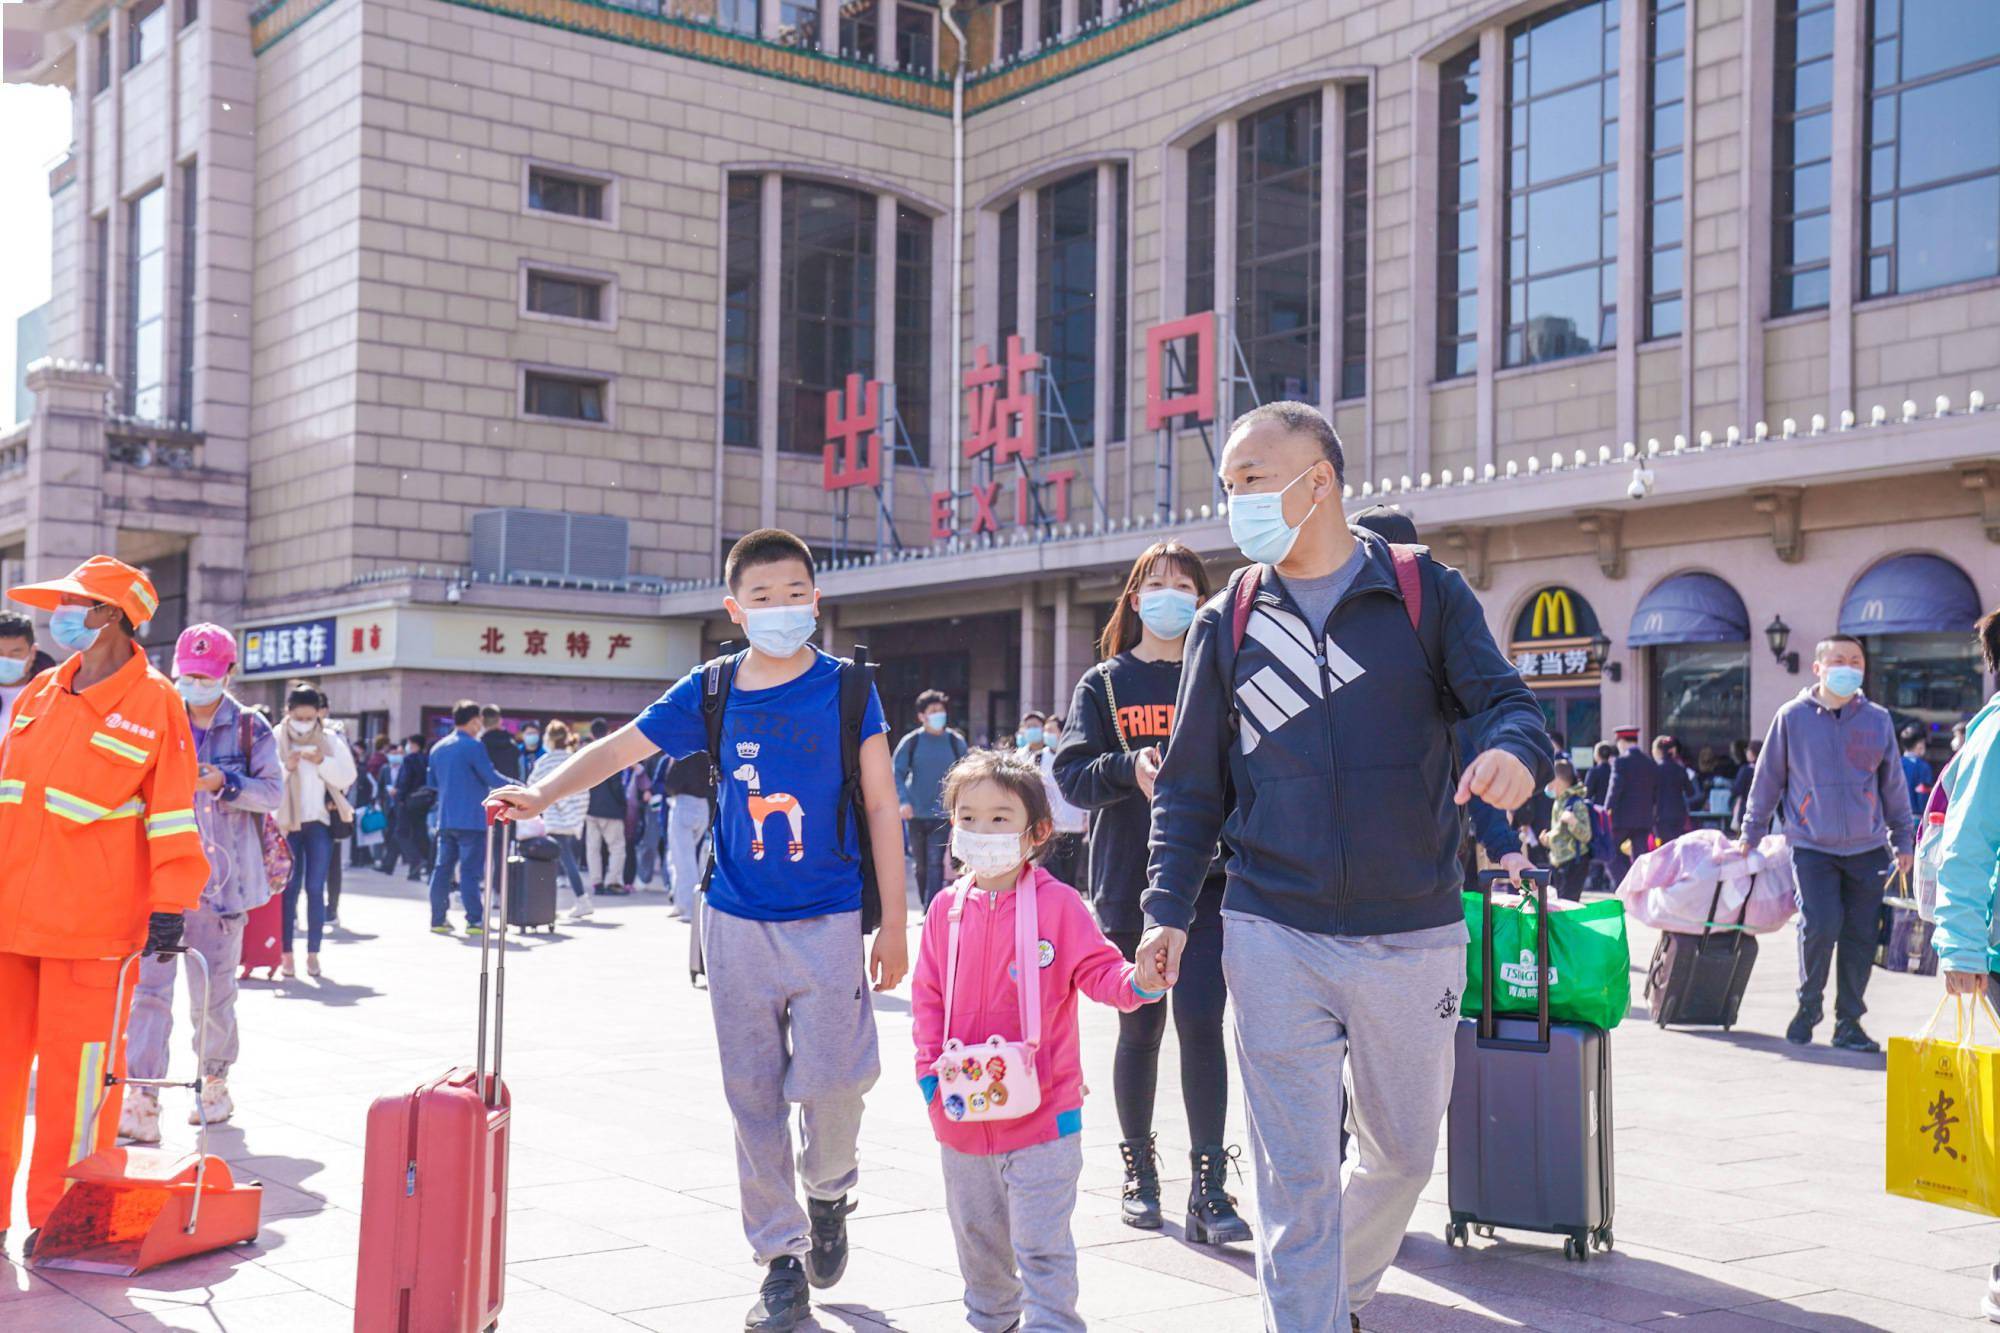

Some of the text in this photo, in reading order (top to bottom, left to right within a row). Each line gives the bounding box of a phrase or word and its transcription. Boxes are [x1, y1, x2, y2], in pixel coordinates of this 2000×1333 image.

[823, 311, 1214, 491] 出站口
[930, 470, 1075, 539] EXIT
[480, 627, 632, 659] 北京特产
[1516, 650, 1588, 676] 麦当劳
